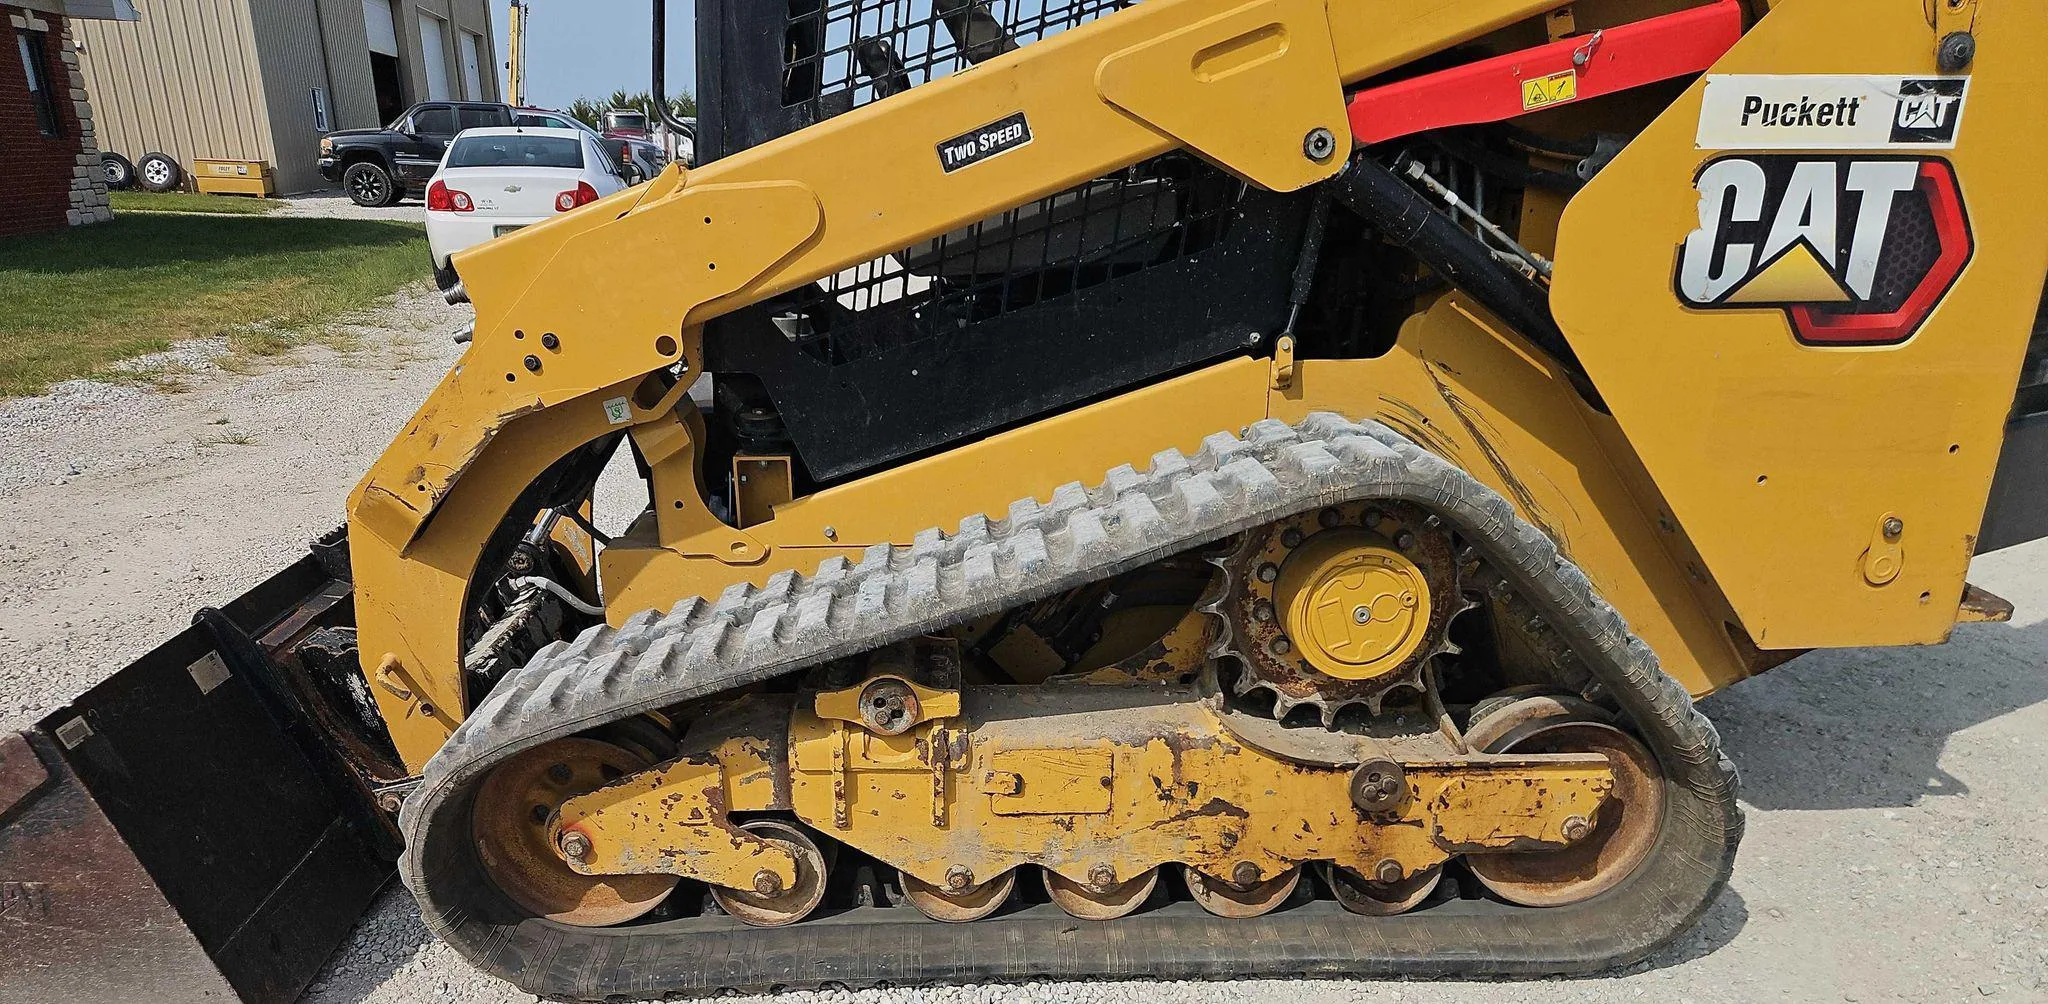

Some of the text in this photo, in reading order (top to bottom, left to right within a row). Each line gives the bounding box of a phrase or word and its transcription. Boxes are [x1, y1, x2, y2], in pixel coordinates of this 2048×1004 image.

[1740, 95, 1954, 129] Puckett CAT
[944, 122, 1023, 165] TWO SPEED
[1680, 158, 1920, 303] CAT
